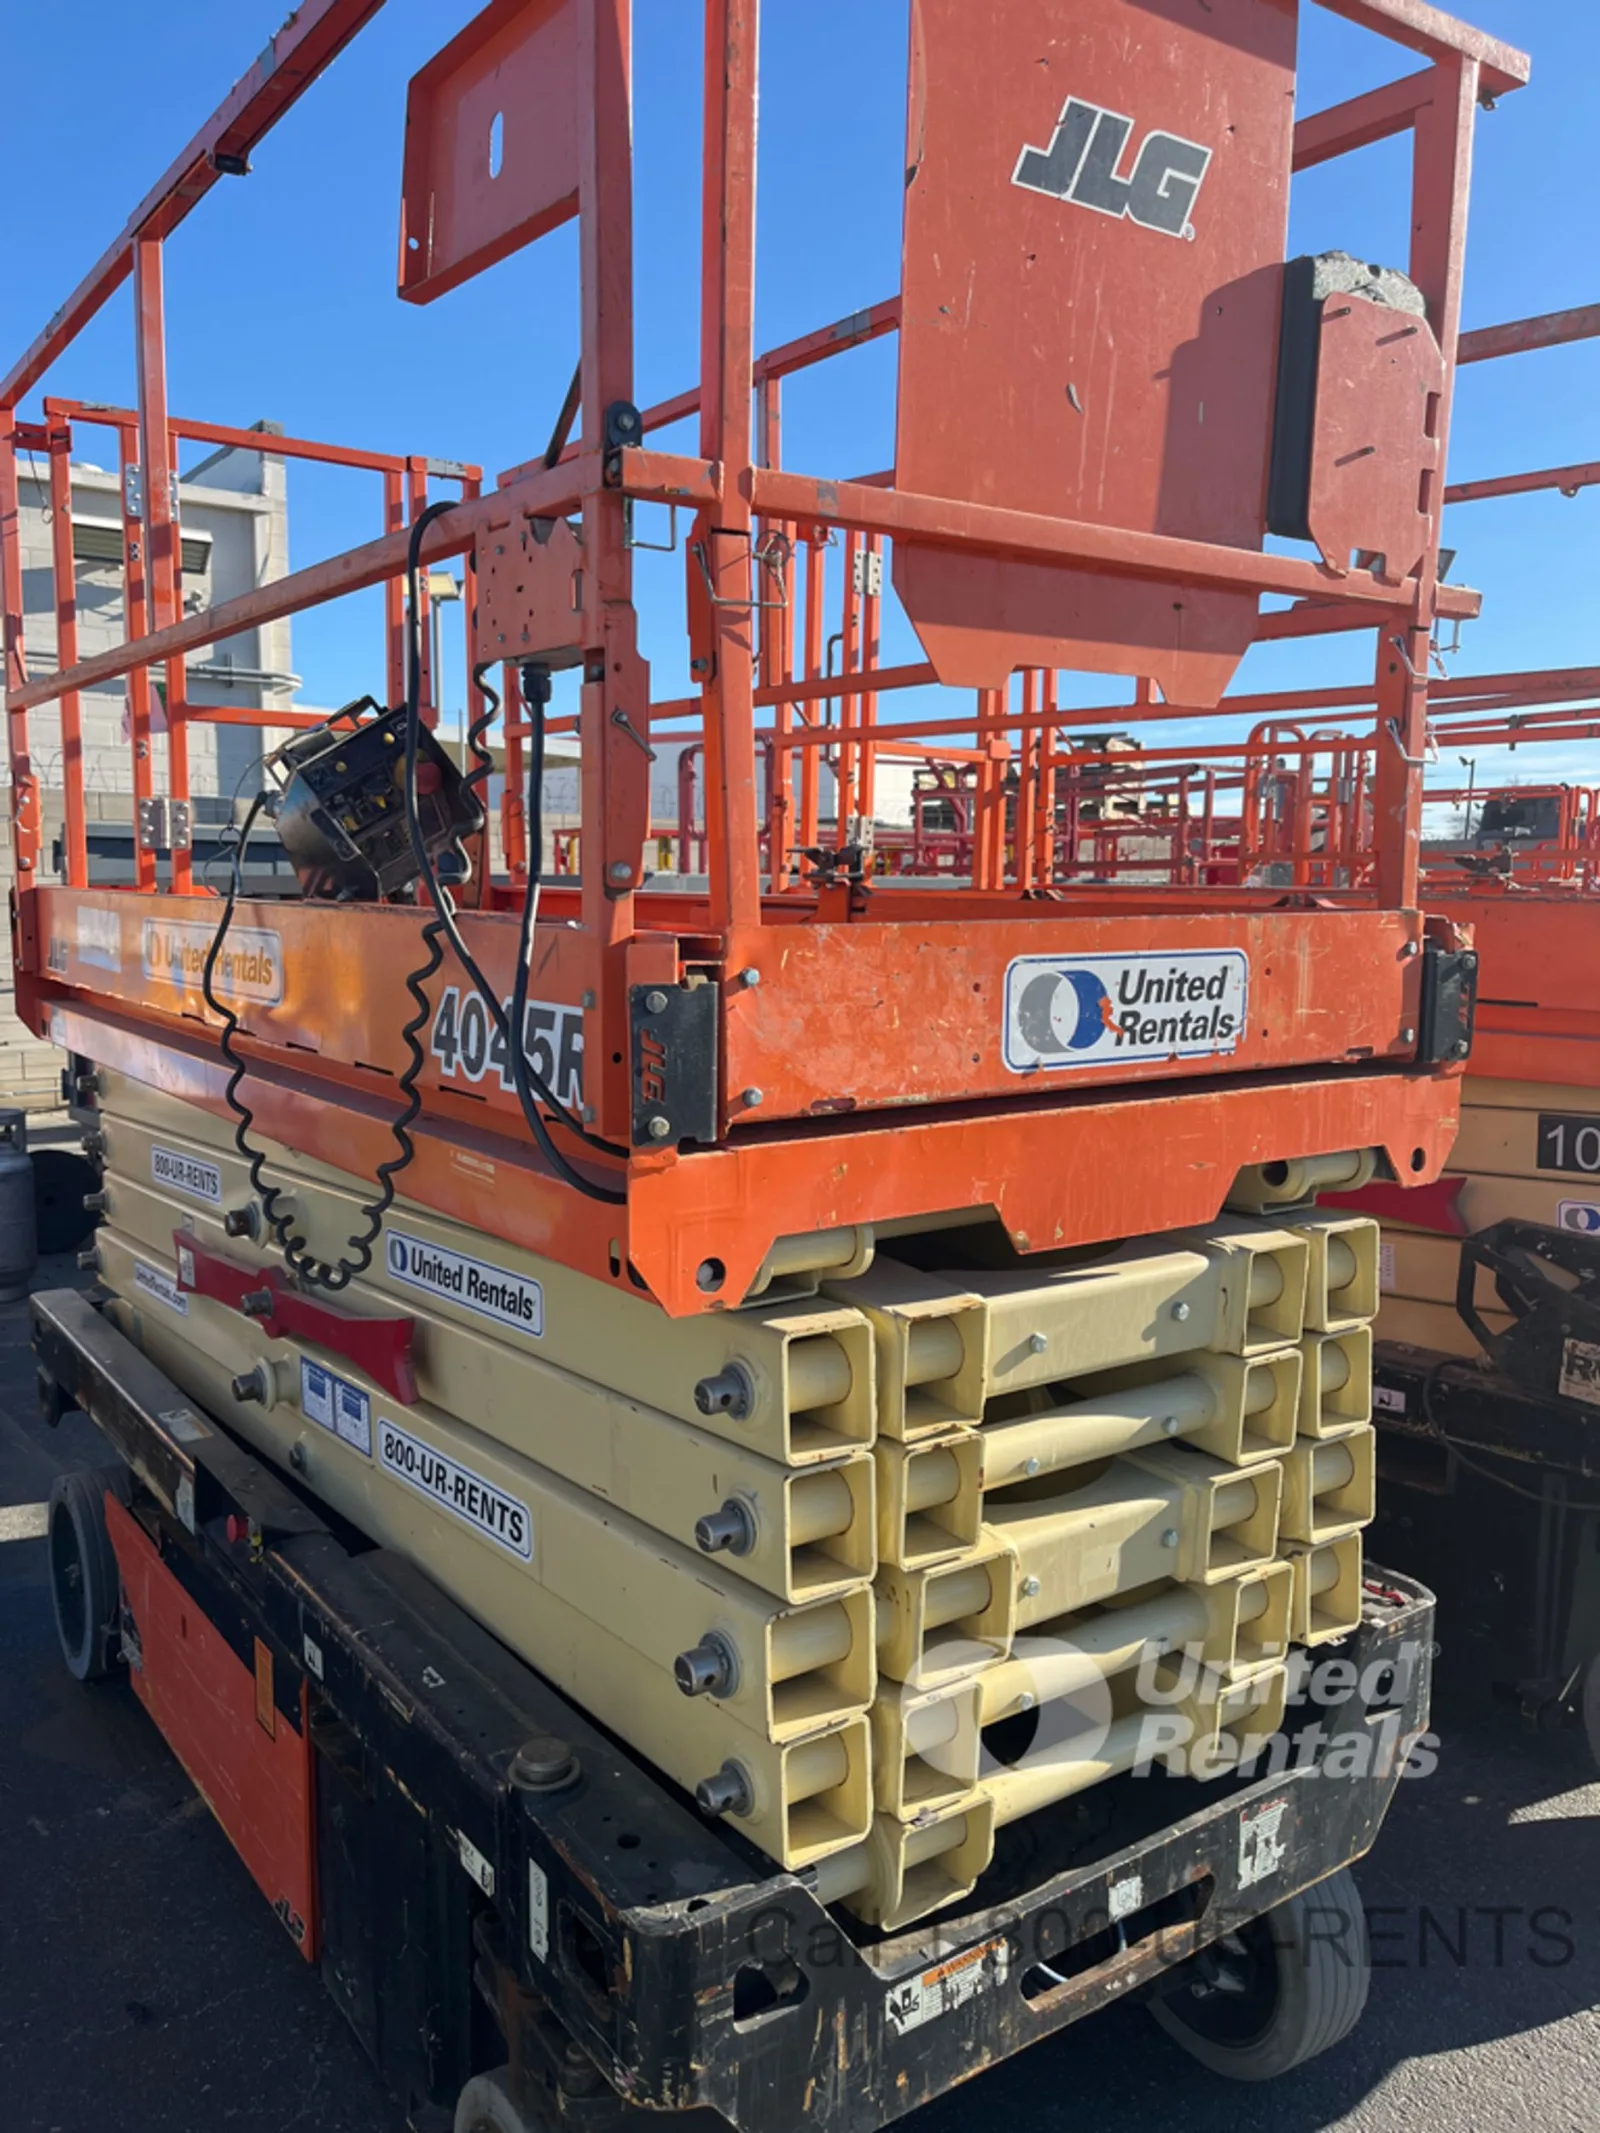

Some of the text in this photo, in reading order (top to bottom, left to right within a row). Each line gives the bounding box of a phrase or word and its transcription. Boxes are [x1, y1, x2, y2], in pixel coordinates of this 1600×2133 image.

[1012, 96, 1213, 238] JLG
[1118, 965, 1229, 1006] United
[1114, 1005, 1235, 1047] Rentals
[640, 1029, 668, 1105] JLG
[153, 1153, 219, 1195] 800-UR-RENTS
[1546, 1124, 1600, 1170] 10
[411, 1246, 534, 1321] United Rentals
[384, 1432, 525, 1544] 800-UR-RENTS
